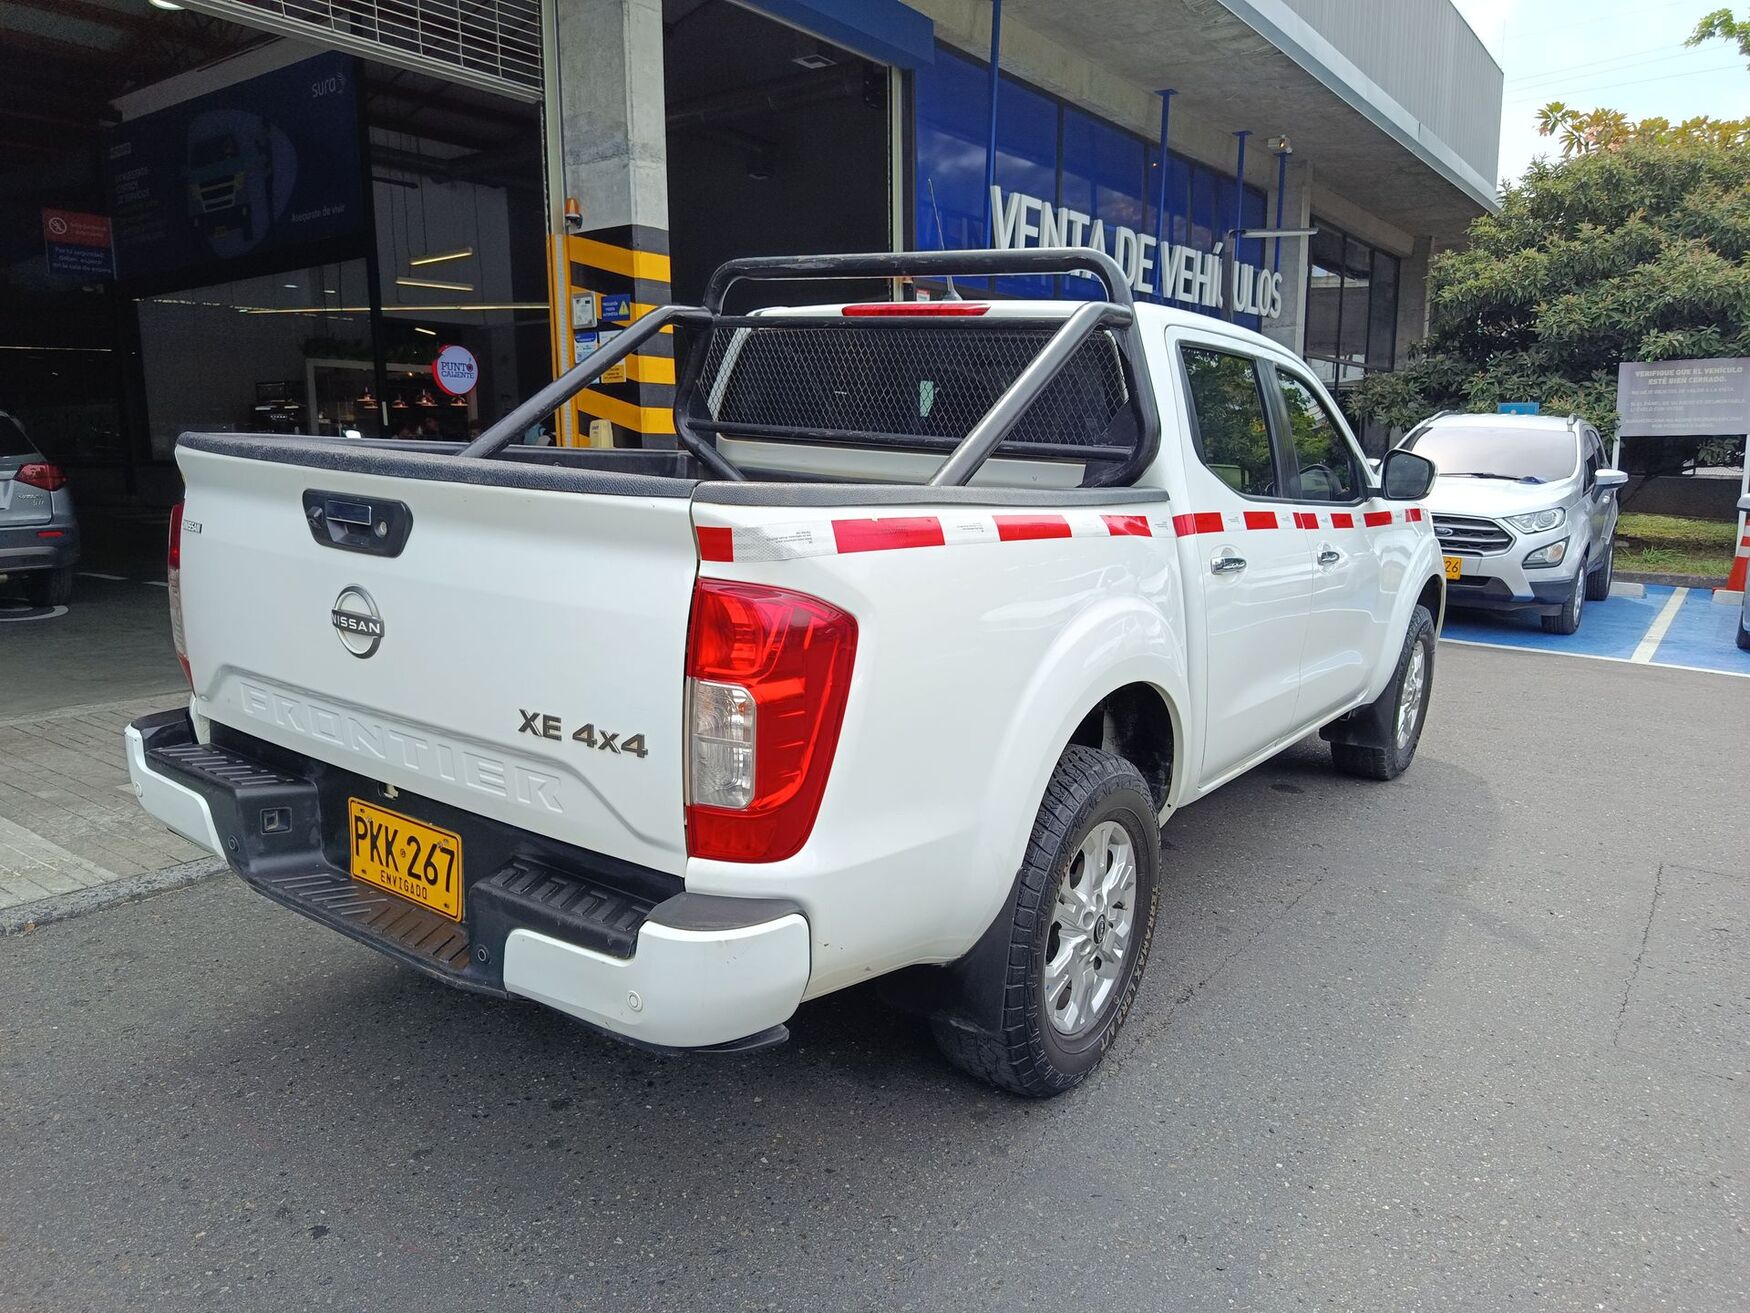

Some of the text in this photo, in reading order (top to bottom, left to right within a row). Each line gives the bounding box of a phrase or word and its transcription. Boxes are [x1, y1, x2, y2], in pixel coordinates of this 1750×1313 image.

[312, 77, 336, 98] sura
[990, 185, 1282, 319] VENTA DE VEHÍULOS
[441, 362, 474, 372] PUNTO
[441, 371, 474, 379] CALIENTE
[1635, 370, 1674, 378] VERIFIQUE
[332, 612, 380, 634] NISSAN
[519, 708, 649, 758] XE 4x4
[240, 682, 566, 814] FRONTIER
[354, 815, 455, 894] PKK 267
[380, 870, 428, 900] ENVIGADO
